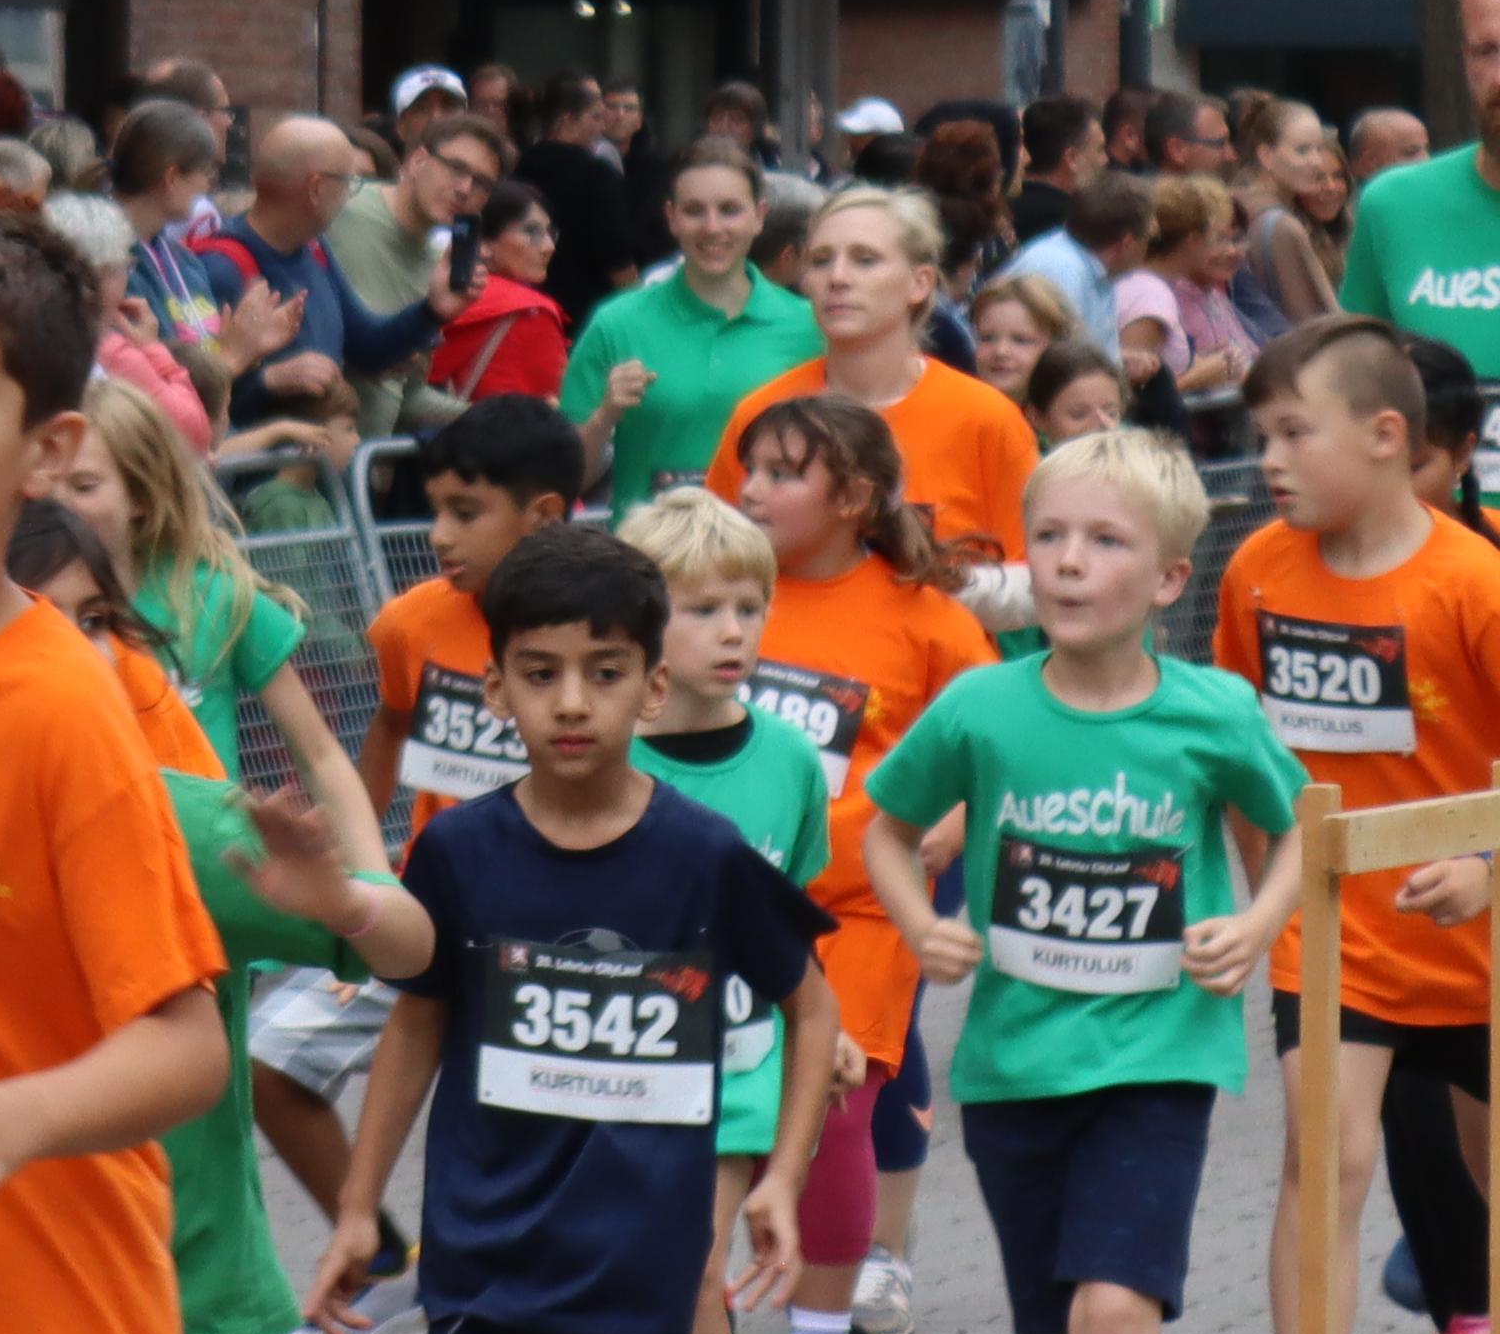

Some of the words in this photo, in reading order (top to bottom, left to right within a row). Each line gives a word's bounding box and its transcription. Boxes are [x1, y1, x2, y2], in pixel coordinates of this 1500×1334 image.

[1407, 264, 1500, 311] Aues
[1268, 644, 1382, 706] 3520
[1280, 713, 1364, 734] KURTULUS
[996, 770, 1186, 840] Aueschule
[1017, 874, 1160, 940] 3427
[1032, 946, 1133, 974] KURTULUS
[511, 983, 680, 1058] 3542
[529, 1068, 648, 1097] KURTULUS
